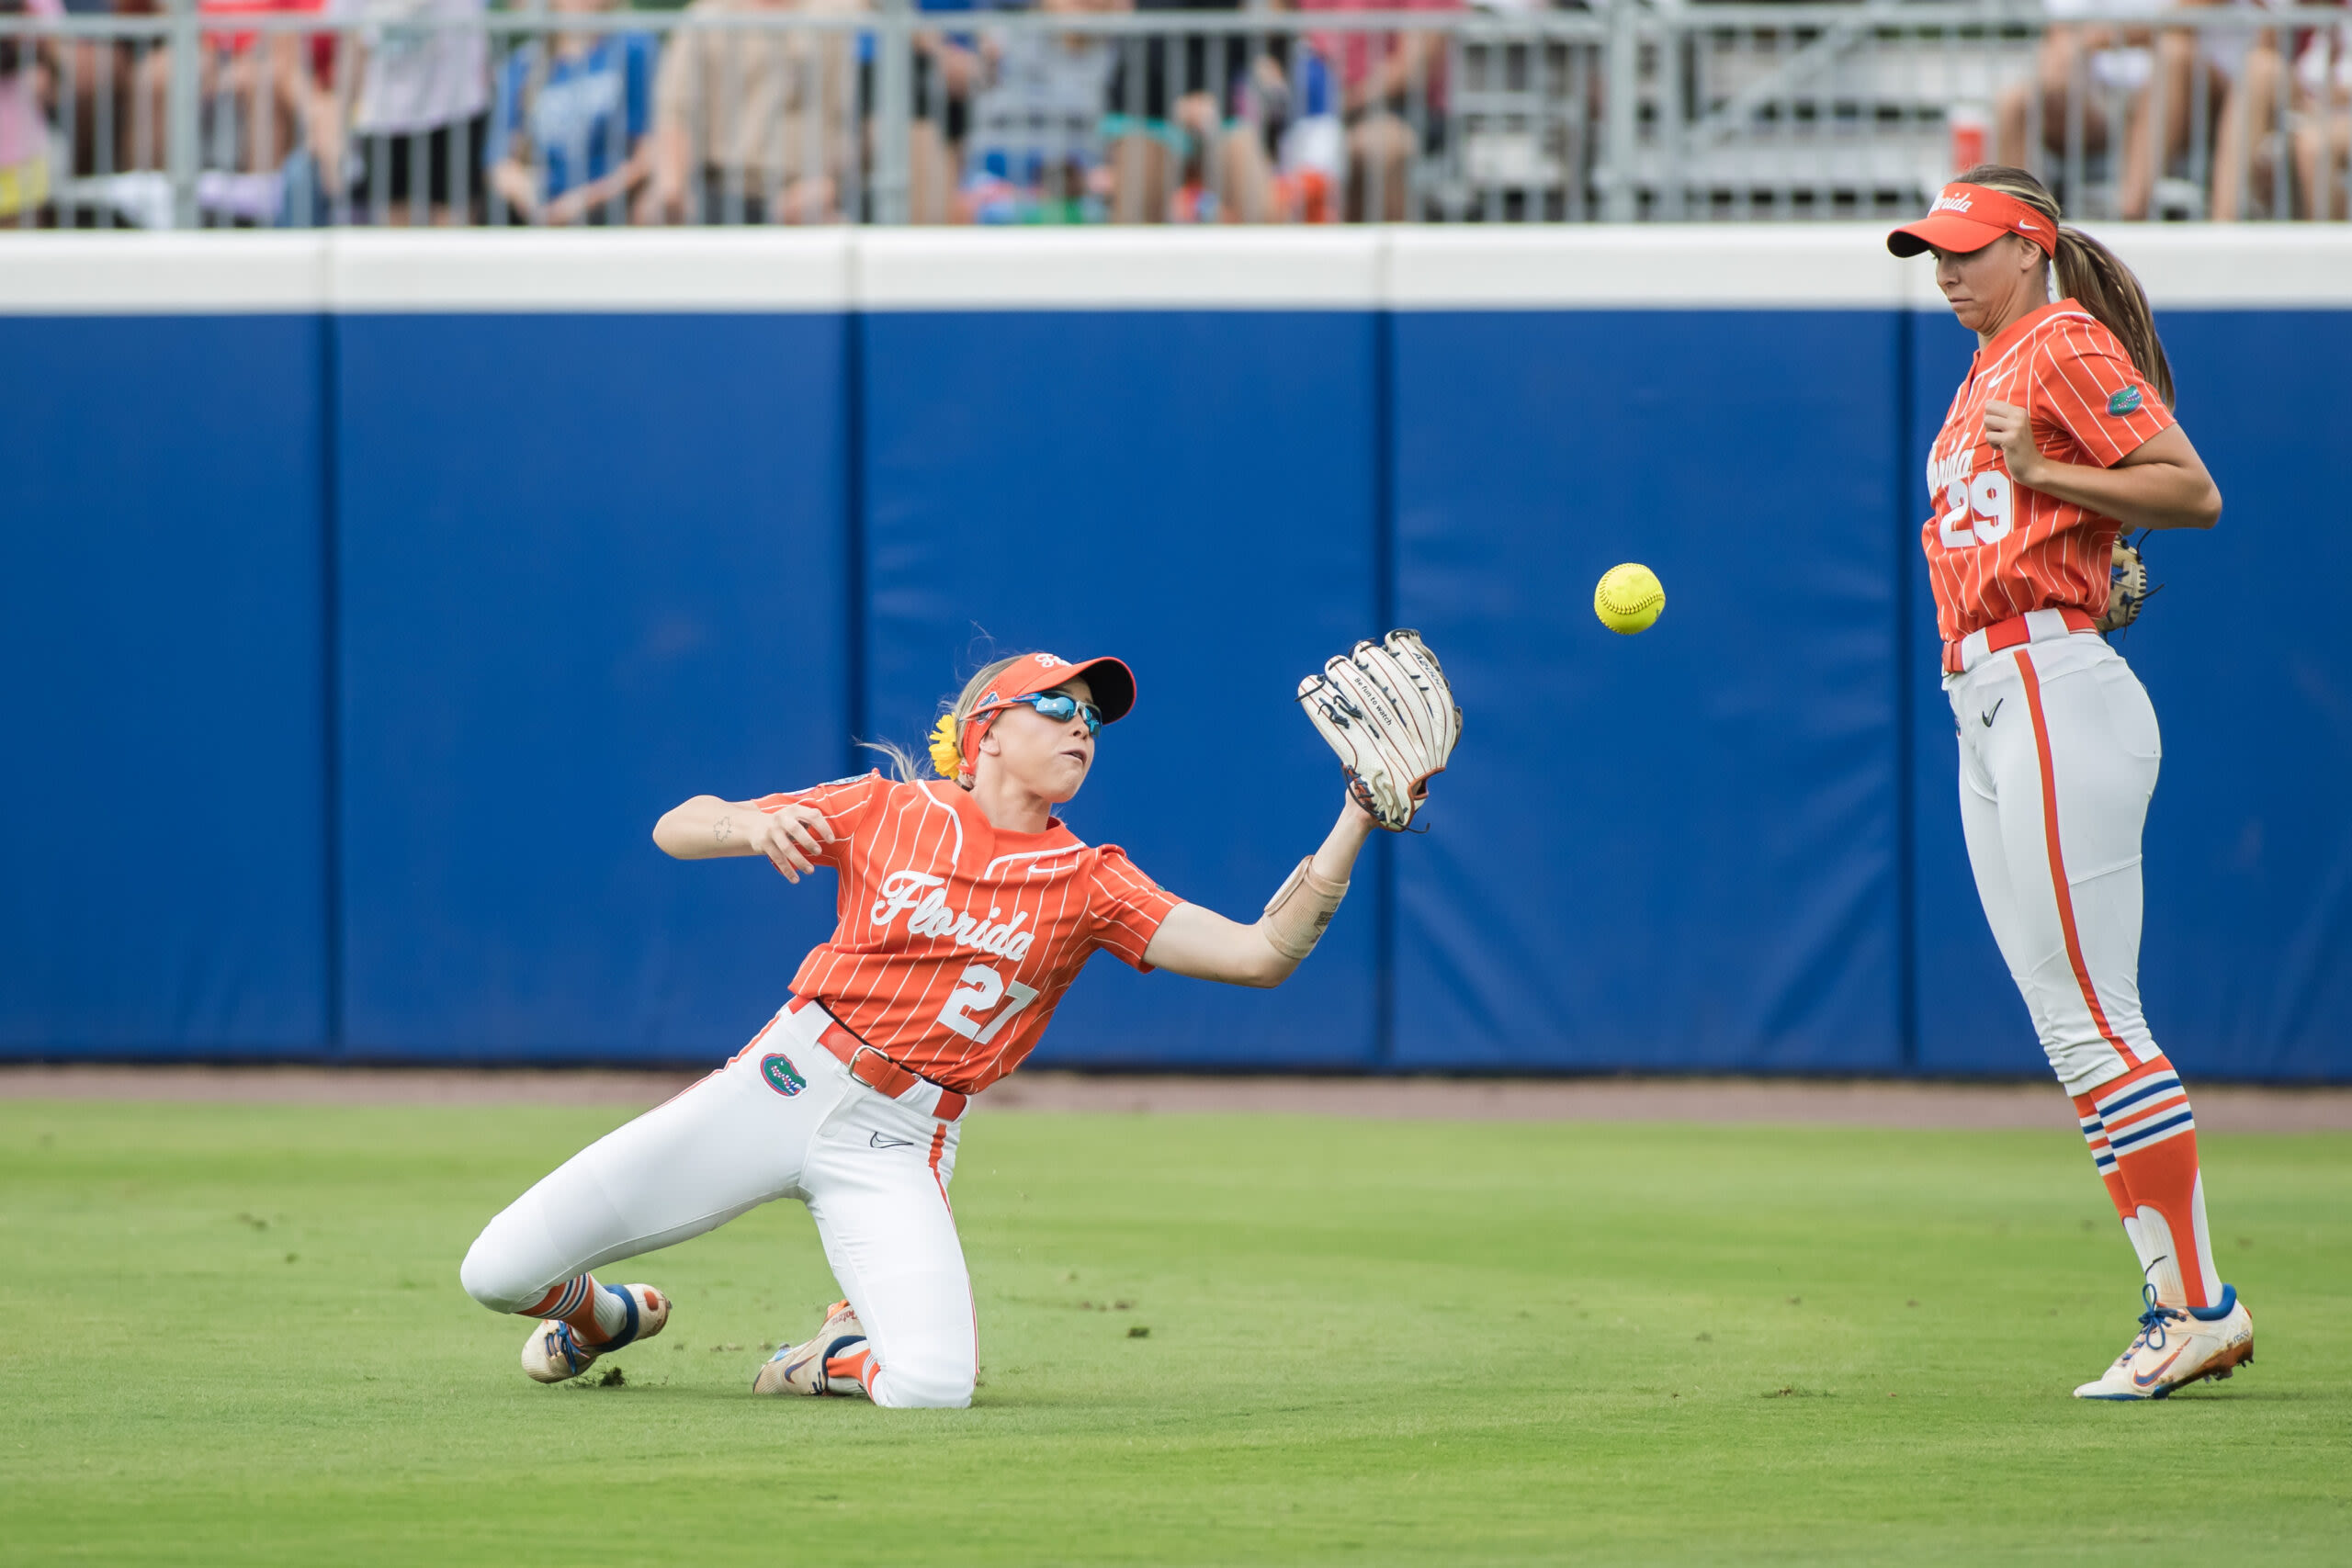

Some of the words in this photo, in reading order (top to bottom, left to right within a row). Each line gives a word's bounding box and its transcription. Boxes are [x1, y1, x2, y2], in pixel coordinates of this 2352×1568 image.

[1939, 469, 2012, 548] 29
[1354, 677, 1363, 686] Be
[1362, 685, 1372, 698] fun
[1370, 696, 1378, 705] to
[1375, 705, 1393, 727] watch
[870, 870, 1035, 962] Florida
[937, 964, 1039, 1045] 27
